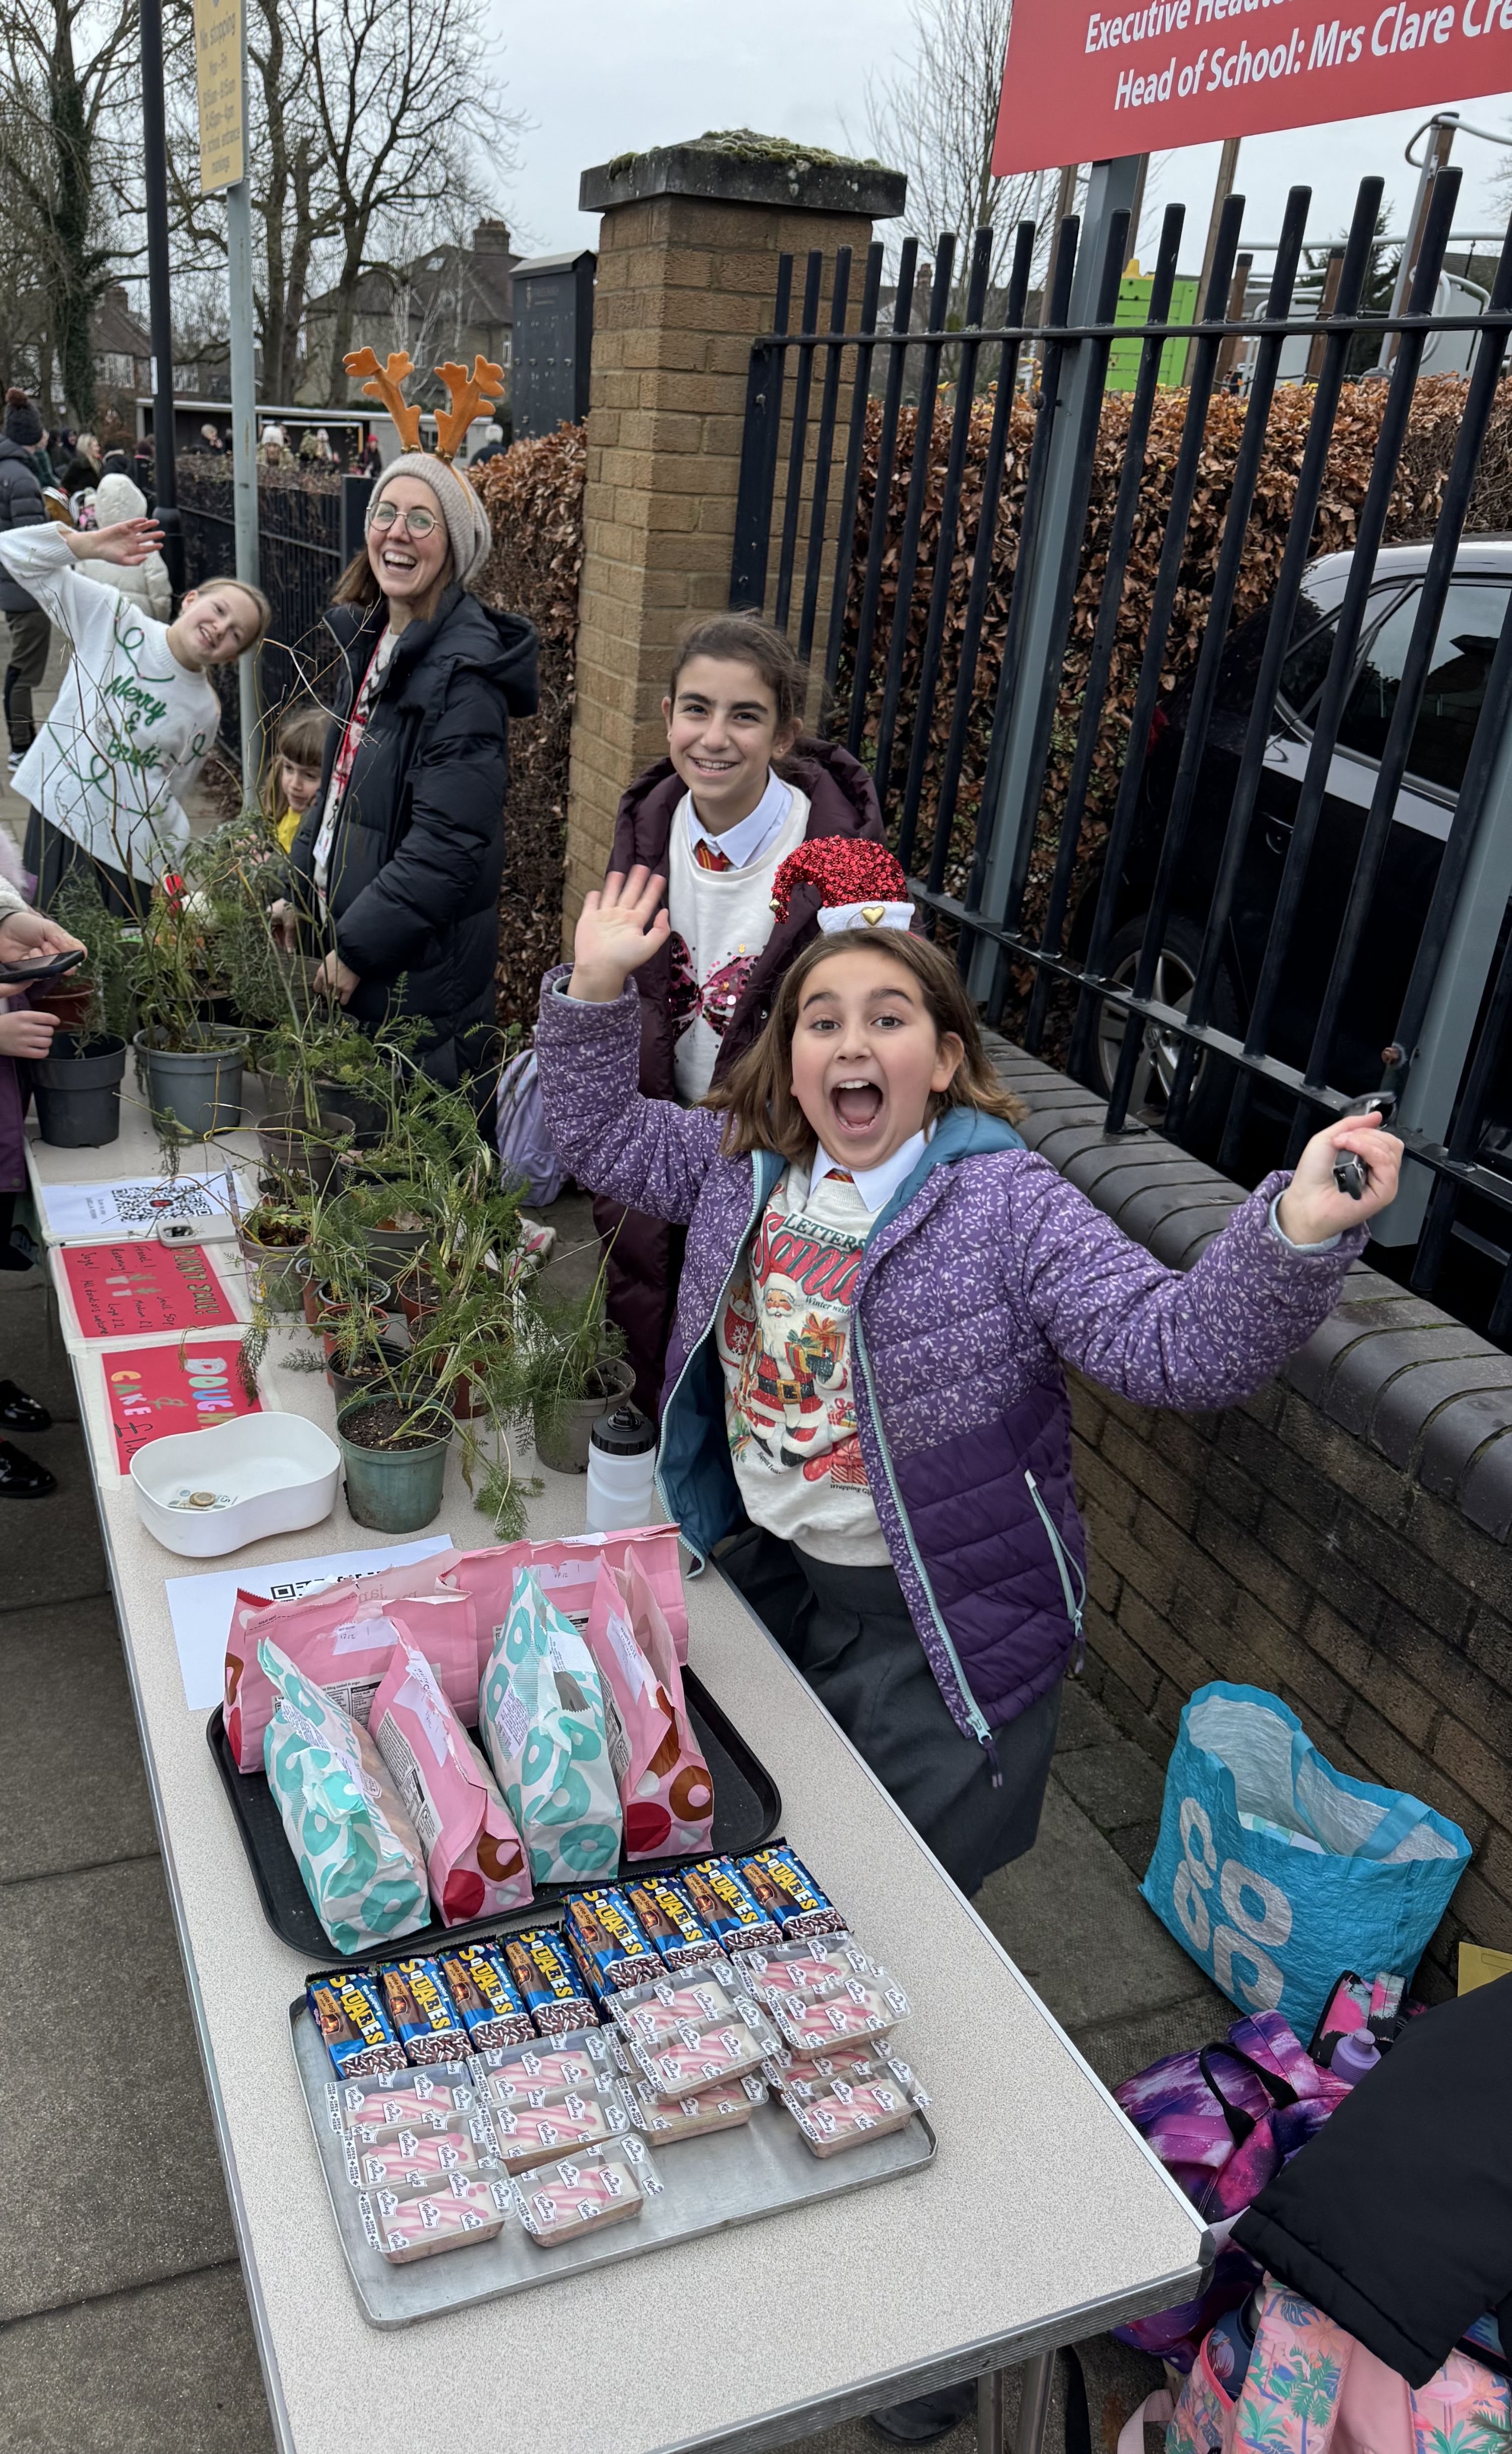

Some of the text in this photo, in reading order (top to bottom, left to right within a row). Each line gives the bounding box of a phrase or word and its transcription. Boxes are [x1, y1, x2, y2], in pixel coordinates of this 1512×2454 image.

[1085, 0, 1191, 53] Executive
[1114, 57, 1176, 110] Head
[1178, 49, 1208, 97] of
[1206, 28, 1305, 91] School:
[1307, 20, 1365, 70] Mrs
[1371, 2, 1455, 56] Clare
[104, 675, 166, 726] Merry
[783, 1213, 866, 1250] LETTERS
[170, 1247, 207, 1280] PLANT
[806, 1296, 832, 1310] Winter
[184, 1357, 237, 1429] DOUGH
[111, 1371, 153, 1460] CAKE £1.0
[688, 1875, 708, 1894] yule log
[754, 1849, 818, 1910] SQUARES
[635, 1891, 646, 1901] yule
[696, 1859, 759, 1923] SQUARES
[574, 1903, 593, 1924] yule log
[642, 1878, 703, 1941] SQUARES
[583, 1889, 644, 1954] SQUARES
[509, 1944, 520, 1955] yule
[811, 1941, 823, 1962] Kipling
[448, 1961, 459, 1974] yule
[520, 1931, 574, 1997] SQUARES
[751, 1952, 762, 1973] Kipling
[849, 1951, 861, 1972] Kipling
[388, 1974, 399, 1987] yule
[459, 1945, 514, 2014] SQUARES
[715, 1964, 729, 1984] Kipling
[790, 1966, 802, 1985] Kipling
[319, 1991, 330, 2004] yule
[399, 1958, 451, 2030] SQUARES
[656, 1985, 671, 2006] Kipling
[697, 1992, 711, 2010] Kipling
[848, 1981, 861, 2003] Kipling
[888, 1991, 902, 2011] Kipling
[329, 1974, 386, 2044] SQUARES
[741, 2006, 755, 2027] Kipling
[788, 1998, 802, 2019] Kipling
[828, 2009, 842, 2030] Kipling
[637, 2012, 651, 2033] Kipling
[589, 2037, 600, 2058] Kipling
[682, 2028, 697, 2050] Kipling
[723, 2034, 738, 2055] Kipling
[635, 2047, 643, 2060] HERE
[638, 2046, 646, 2057] OPEN
[525, 2054, 535, 2075] Kipling
[644, 2065, 652, 2080] HERE
[648, 2063, 657, 2076] OPEN
[663, 2057, 677, 2079] Kipling
[891, 2060, 907, 2081] Kipling
[417, 2076, 426, 2098] Kipling
[745, 2077, 757, 2099] Kipling
[834, 2081, 849, 2103] Kipling
[348, 2089, 356, 2110] Kipling
[456, 2088, 465, 2110] Kipling
[569, 2096, 579, 2118] Kipling
[875, 2088, 890, 2109] Kipling
[500, 2110, 511, 2132] Kipling
[608, 2108, 619, 2130] Kipling
[793, 2109, 802, 2121] HERE
[796, 2107, 805, 2120] OPEN
[816, 2110, 832, 2131] Kipling
[403, 2133, 411, 2156] Kipling
[541, 2124, 551, 2145] Kipling
[442, 2146, 450, 2168] Kipling
[624, 2139, 640, 2162] Kipling
[370, 2159, 379, 2181] Kipling
[561, 2164, 575, 2187] Kipling
[453, 2174, 462, 2197] Kipling
[603, 2170, 618, 2194] Kipling
[380, 2192, 390, 2215] Kipling
[495, 2184, 505, 2207] Kipling
[422, 2204, 432, 2227] Kipling
[537, 2195, 551, 2219] Kipling
